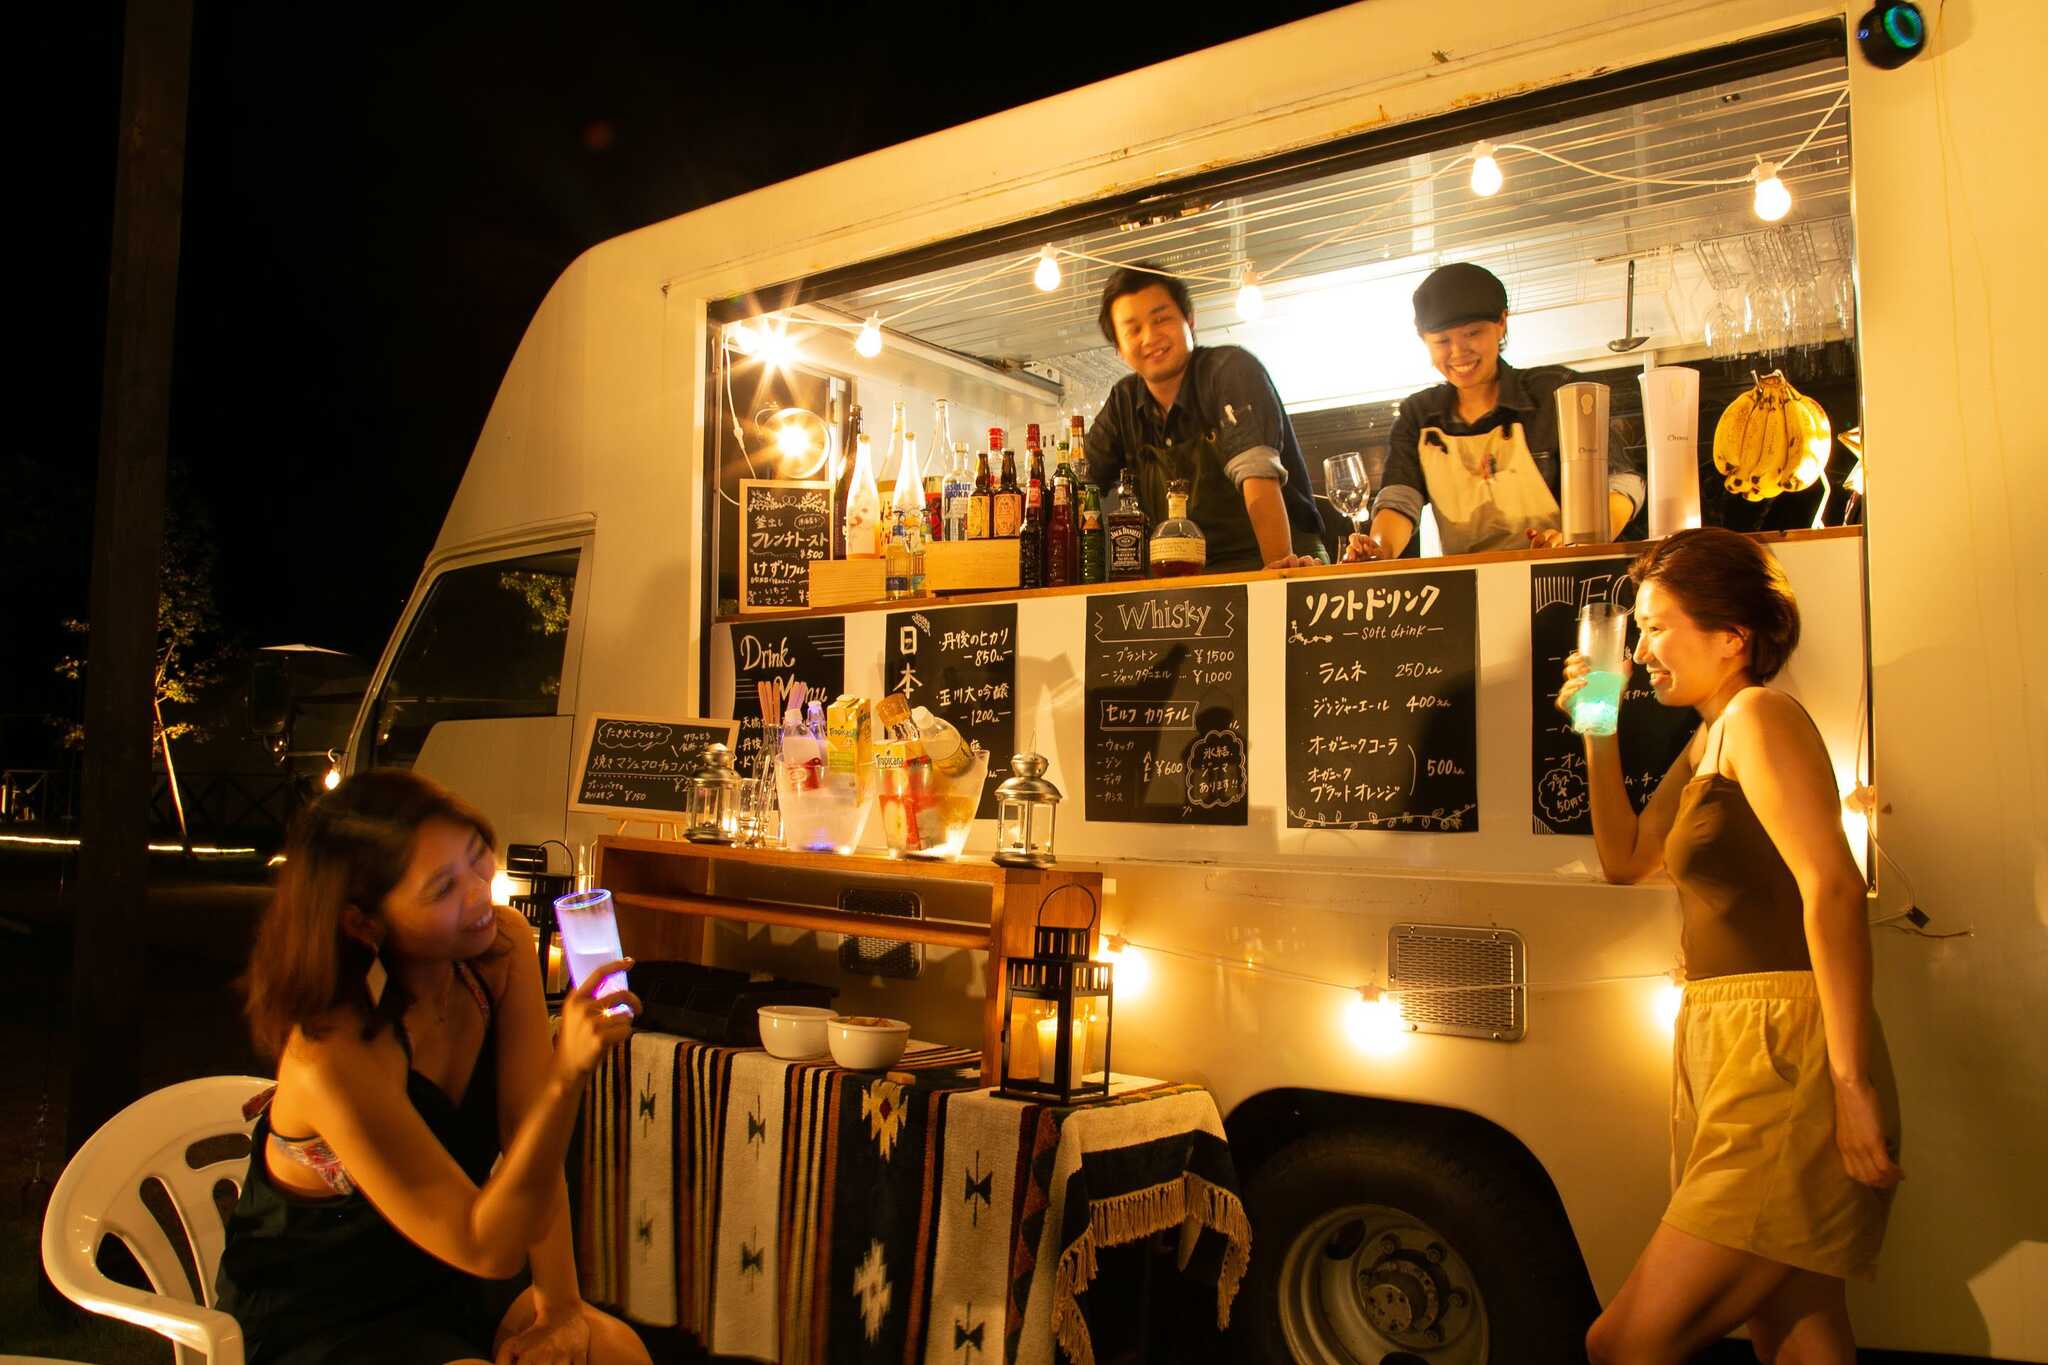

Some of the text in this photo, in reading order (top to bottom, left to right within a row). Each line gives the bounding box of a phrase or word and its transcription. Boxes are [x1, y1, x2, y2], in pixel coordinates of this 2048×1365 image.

[751, 530, 829, 548] フレンチトースト
[799, 549, 824, 560] ¥500
[1305, 584, 1441, 627] ソフトドリンク
[1117, 598, 1211, 636] Whisky
[740, 634, 797, 671] Drink
[1319, 660, 1367, 684] ラムネ
[773, 672, 829, 704] Mnu
[1313, 697, 1390, 718] ジンジャーエール
[1307, 735, 1398, 756] オーガニックコーラ
[1155, 760, 1183, 776] ¥600
[624, 789, 648, 802] ¥150
